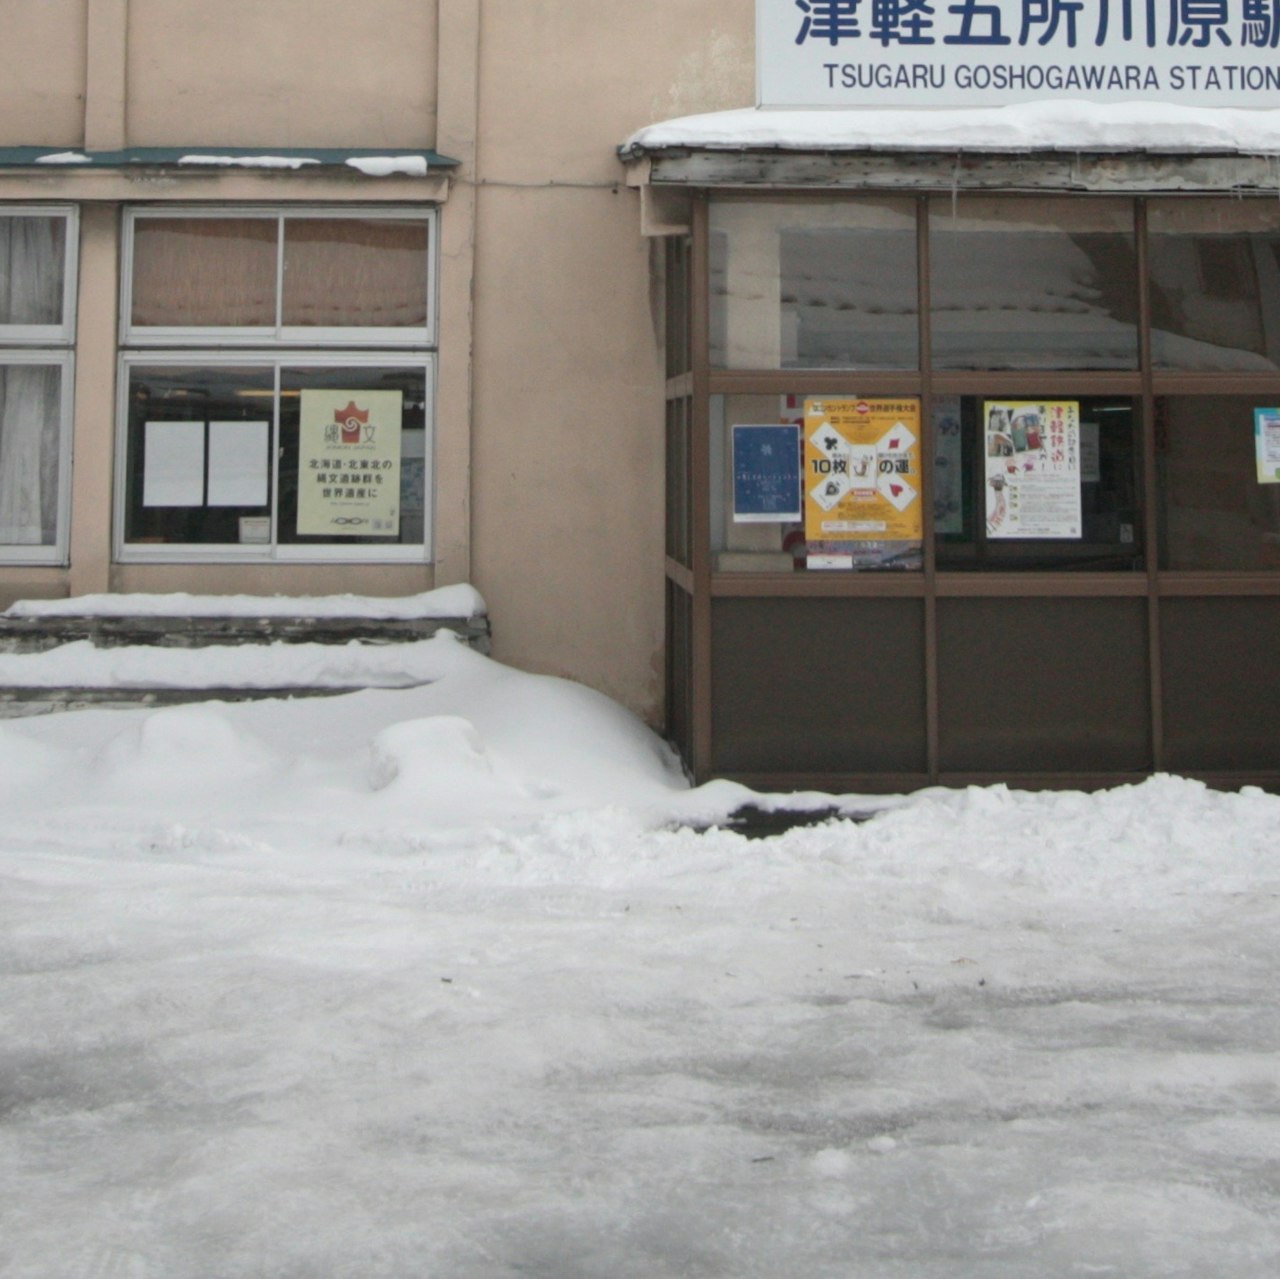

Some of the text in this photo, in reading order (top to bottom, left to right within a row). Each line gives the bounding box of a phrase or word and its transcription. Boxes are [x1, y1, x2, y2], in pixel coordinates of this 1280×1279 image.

[823, 62, 947, 91] TSUGARU
[954, 63, 1161, 91] GOSHOGAWARA
[309, 458, 393, 470] 北海道・北東北の
[811, 459, 847, 474] 10枚
[322, 487, 378, 499] 世界遺産に
